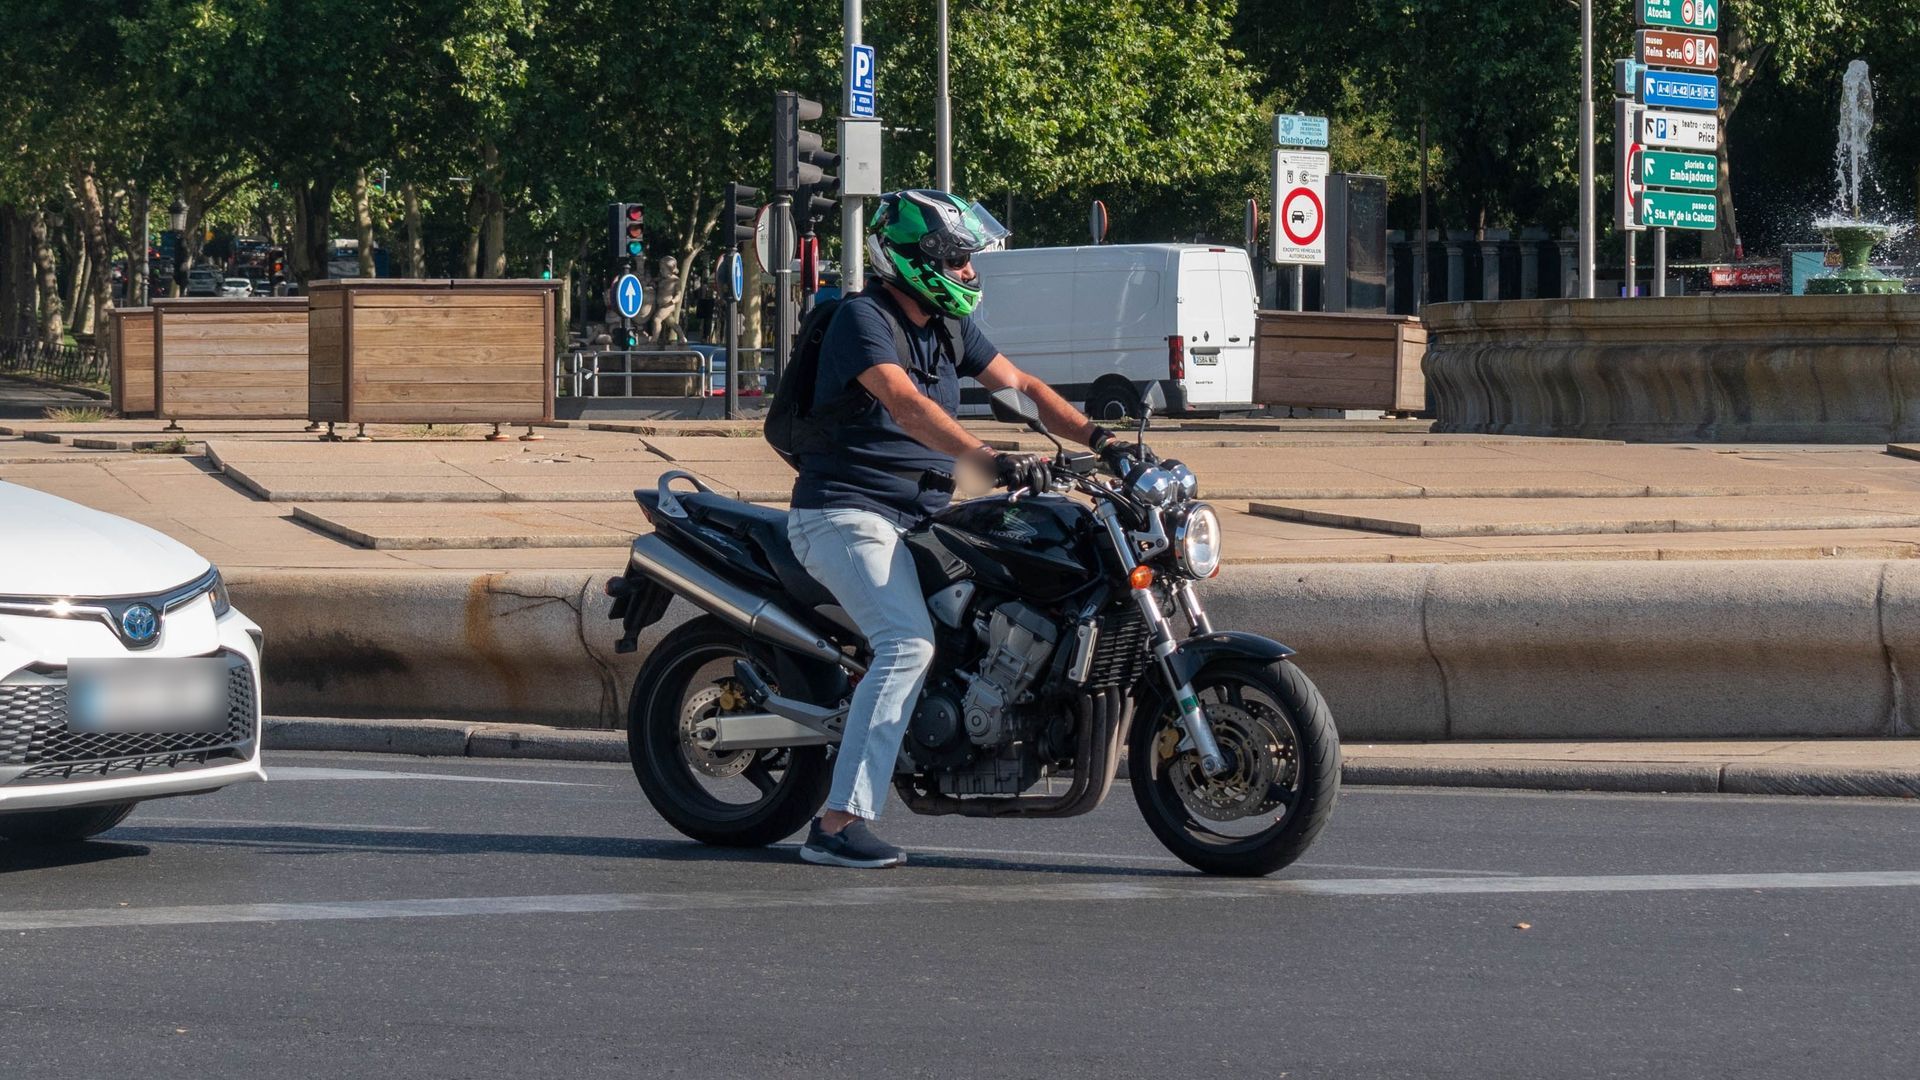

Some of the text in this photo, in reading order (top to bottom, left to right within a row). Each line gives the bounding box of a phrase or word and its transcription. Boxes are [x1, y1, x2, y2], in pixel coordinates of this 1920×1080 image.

[1647, 6, 1671, 19] Atocha
[1646, 37, 1663, 45] museo
[1646, 46, 1663, 57] Reina
[856, 51, 869, 87] P
[1658, 83, 1714, 98] A-4 A-42 A-5 R-5
[1658, 120, 1665, 137] P
[1681, 120, 1698, 128] teatro
[1702, 121, 1715, 130] circo
[1281, 135, 1326, 146] Distrito Centro
[1698, 131, 1715, 143] Price
[1684, 160, 1714, 170] glorieta de
[1670, 169, 1714, 183] Embajadores
[1691, 202, 1715, 210] paseo de
[1676, 210, 1684, 220] de
[1685, 211, 1691, 221] la
[1692, 211, 1714, 222] Cabeza
